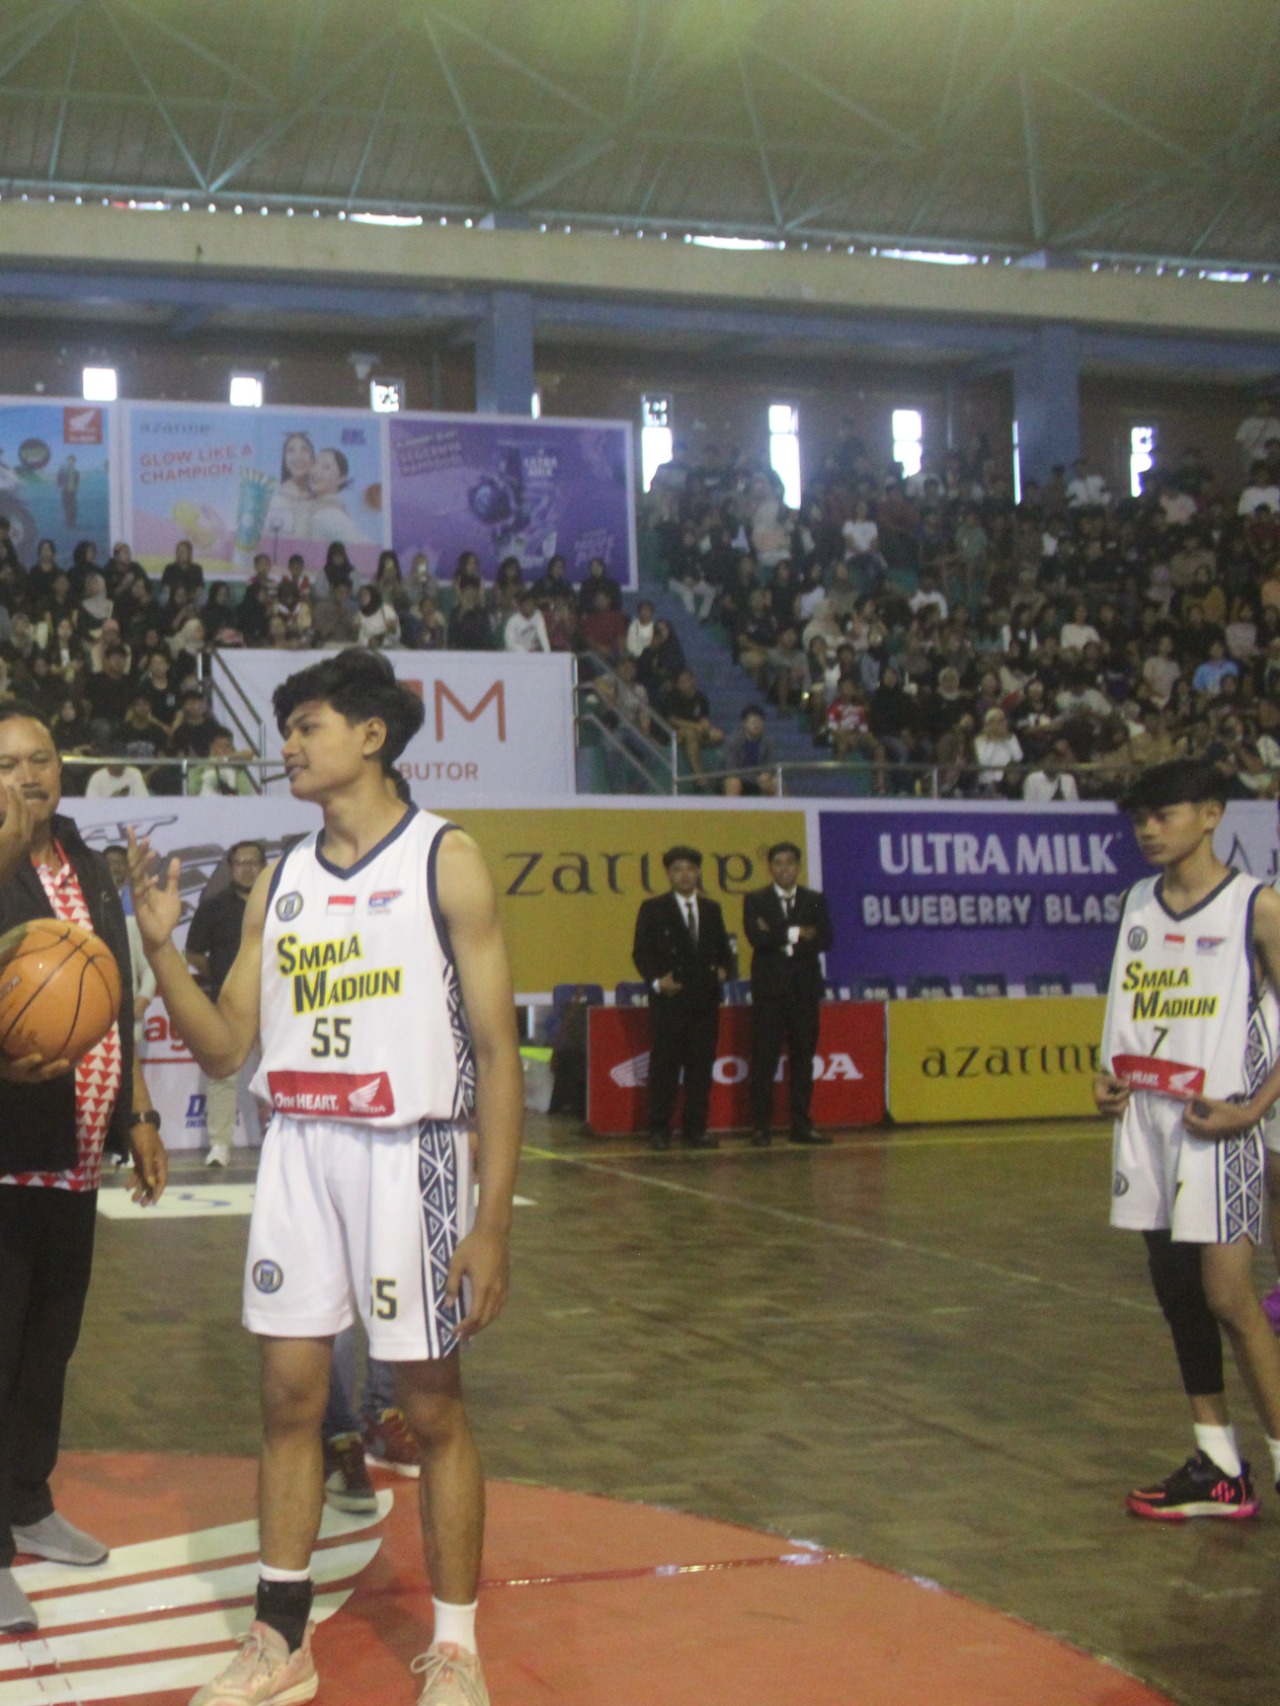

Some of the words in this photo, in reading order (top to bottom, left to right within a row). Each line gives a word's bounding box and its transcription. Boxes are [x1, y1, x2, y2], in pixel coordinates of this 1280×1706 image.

[140, 450, 192, 467] GLOW
[198, 444, 236, 460] LIKE
[242, 442, 254, 457] A
[140, 463, 233, 484] CHAMPION
[398, 762, 478, 781] BUTOR
[879, 833, 1011, 875] ULTRA
[1016, 833, 1118, 875] MILK
[863, 894, 1032, 927] BLUEBERRY
[1044, 893, 1122, 925] BLAS
[276, 932, 364, 977] SMALA
[293, 967, 403, 1014] MADIUN
[1122, 961, 1191, 991] SMALA
[1132, 991, 1219, 1020] MADIUN
[310, 1016, 352, 1058] 55
[1150, 1025, 1169, 1057] 7
[370, 1278, 398, 1321] 5
